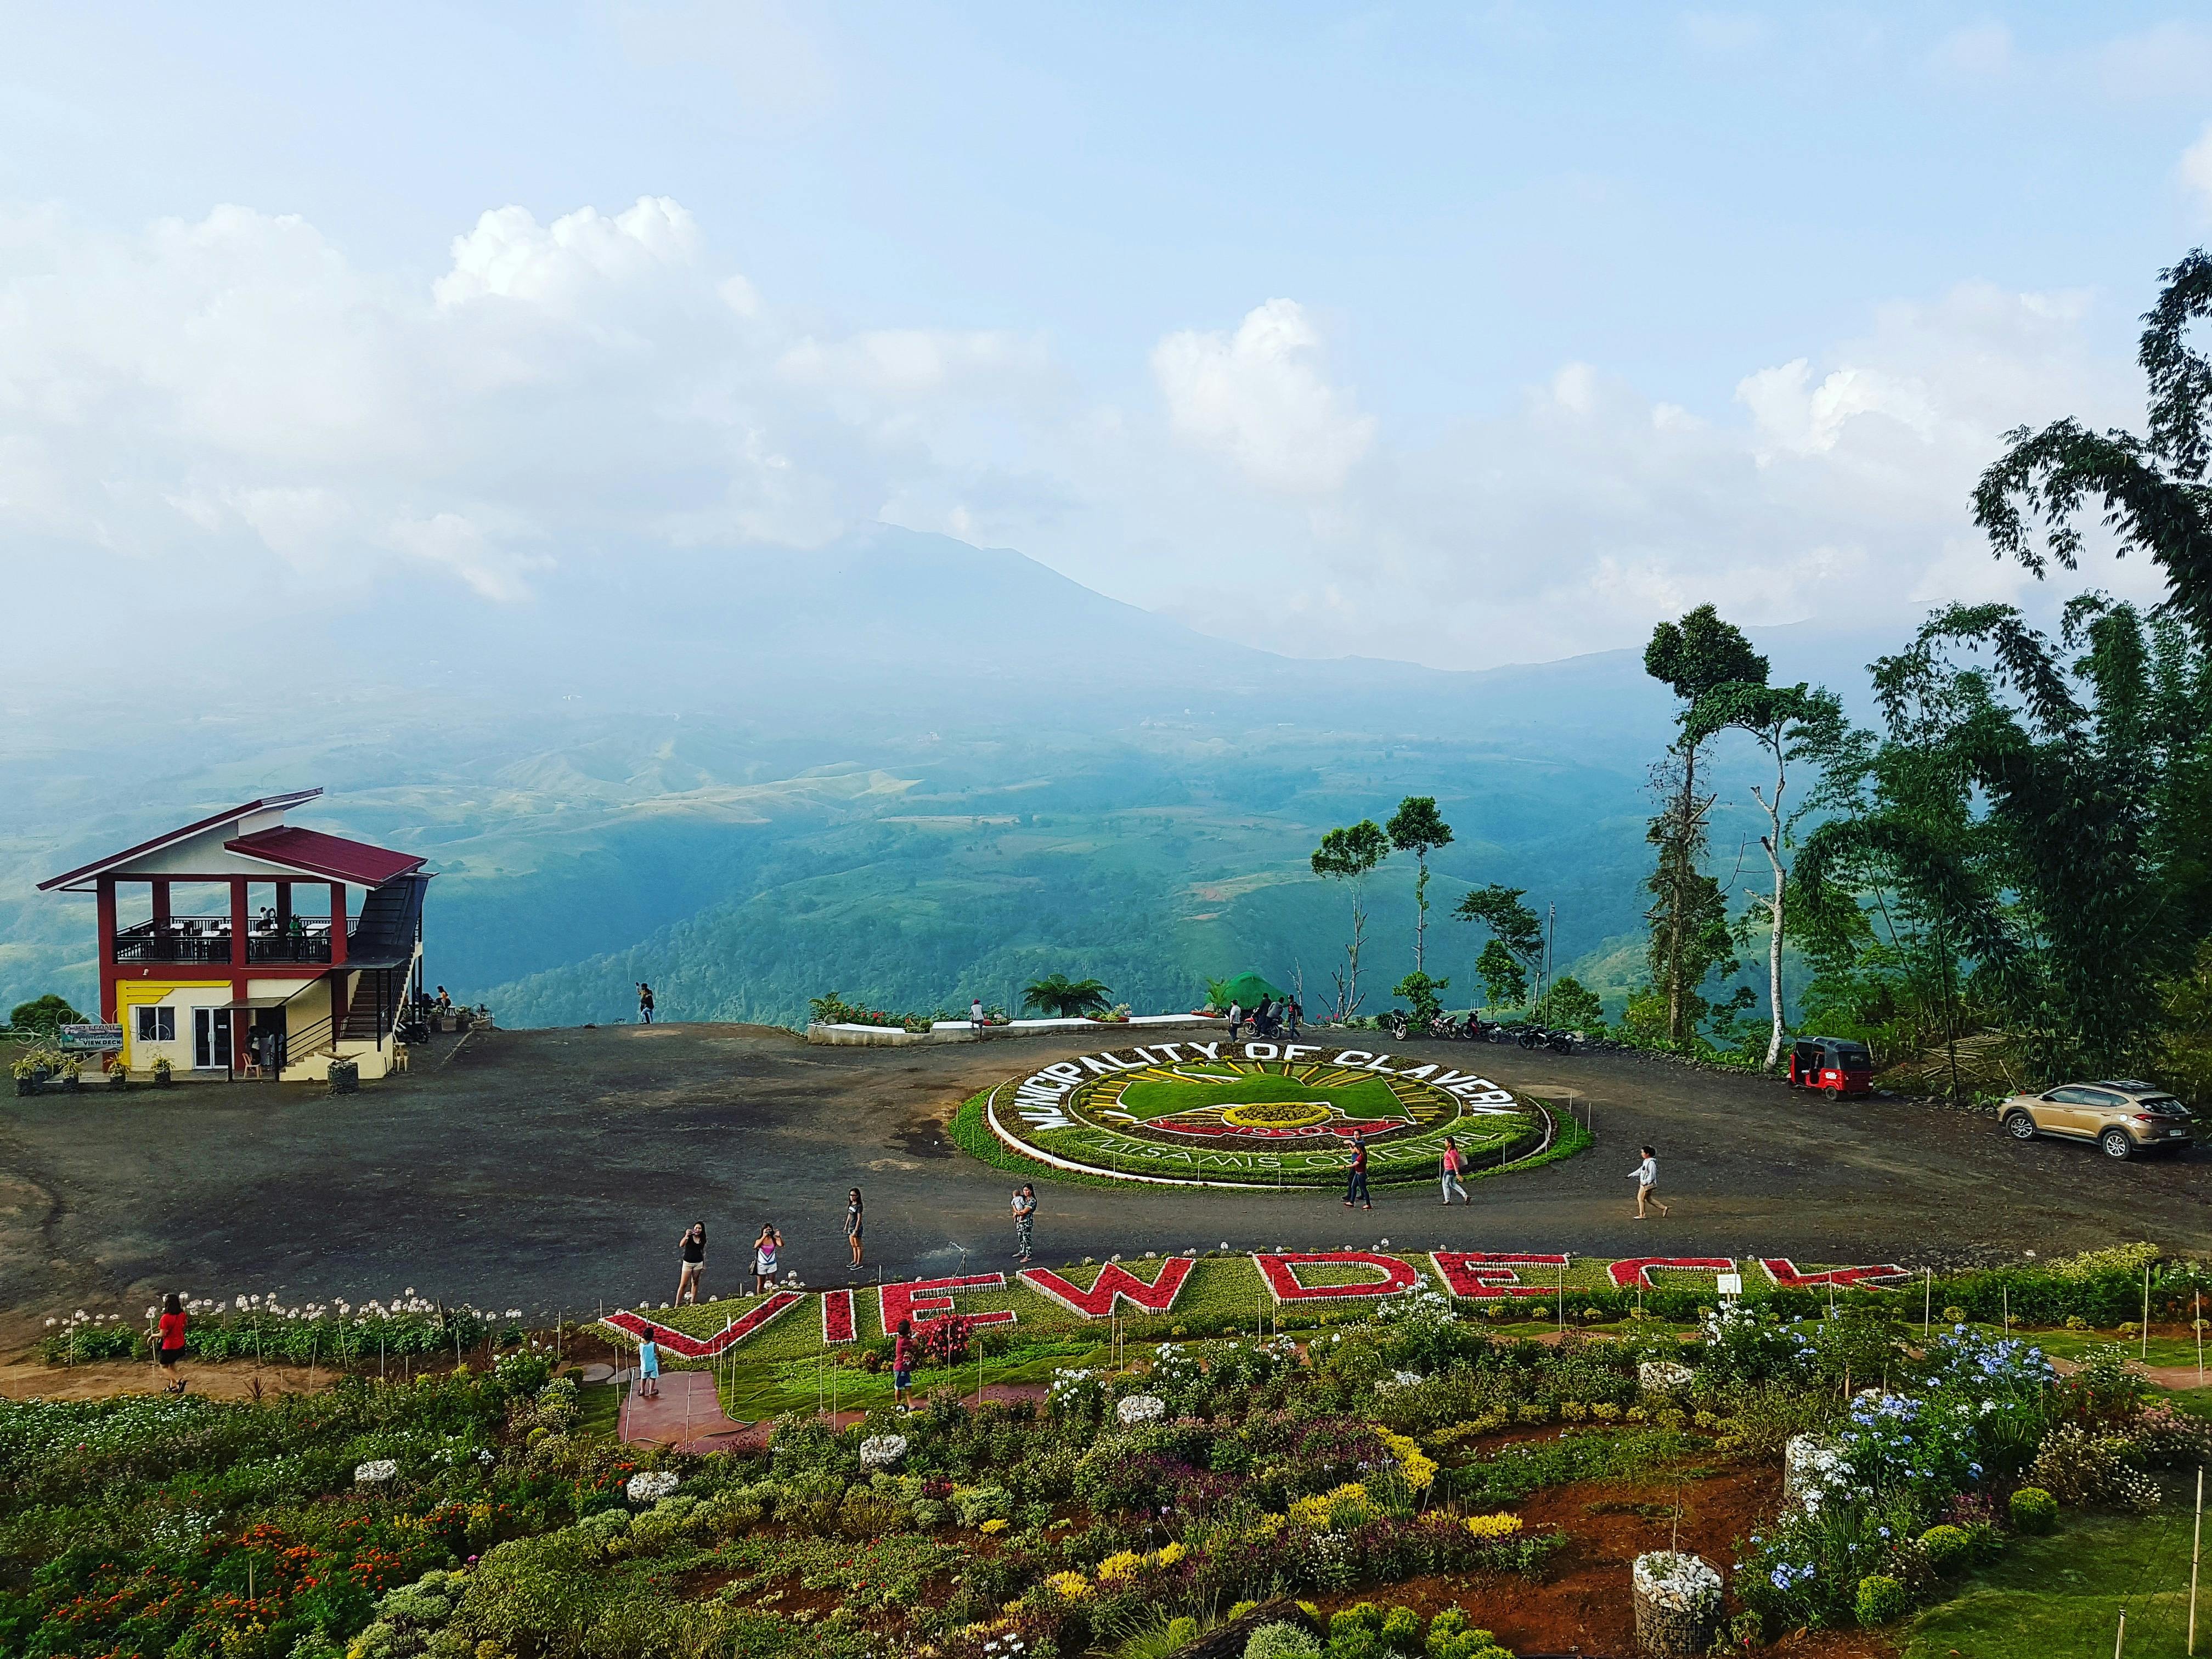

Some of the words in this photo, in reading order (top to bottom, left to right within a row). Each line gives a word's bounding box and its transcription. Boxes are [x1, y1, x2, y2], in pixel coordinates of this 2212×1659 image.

[1014, 1042, 1219, 1130] MUNICIPALITY
[1245, 1042, 1322, 1060] OF
[1082, 1138, 1282, 1167] MISAMIS
[1235, 1126, 1322, 1136] 1950
[597, 1256, 1197, 1359] VIEW
[1252, 1251, 1914, 1305] DECK
